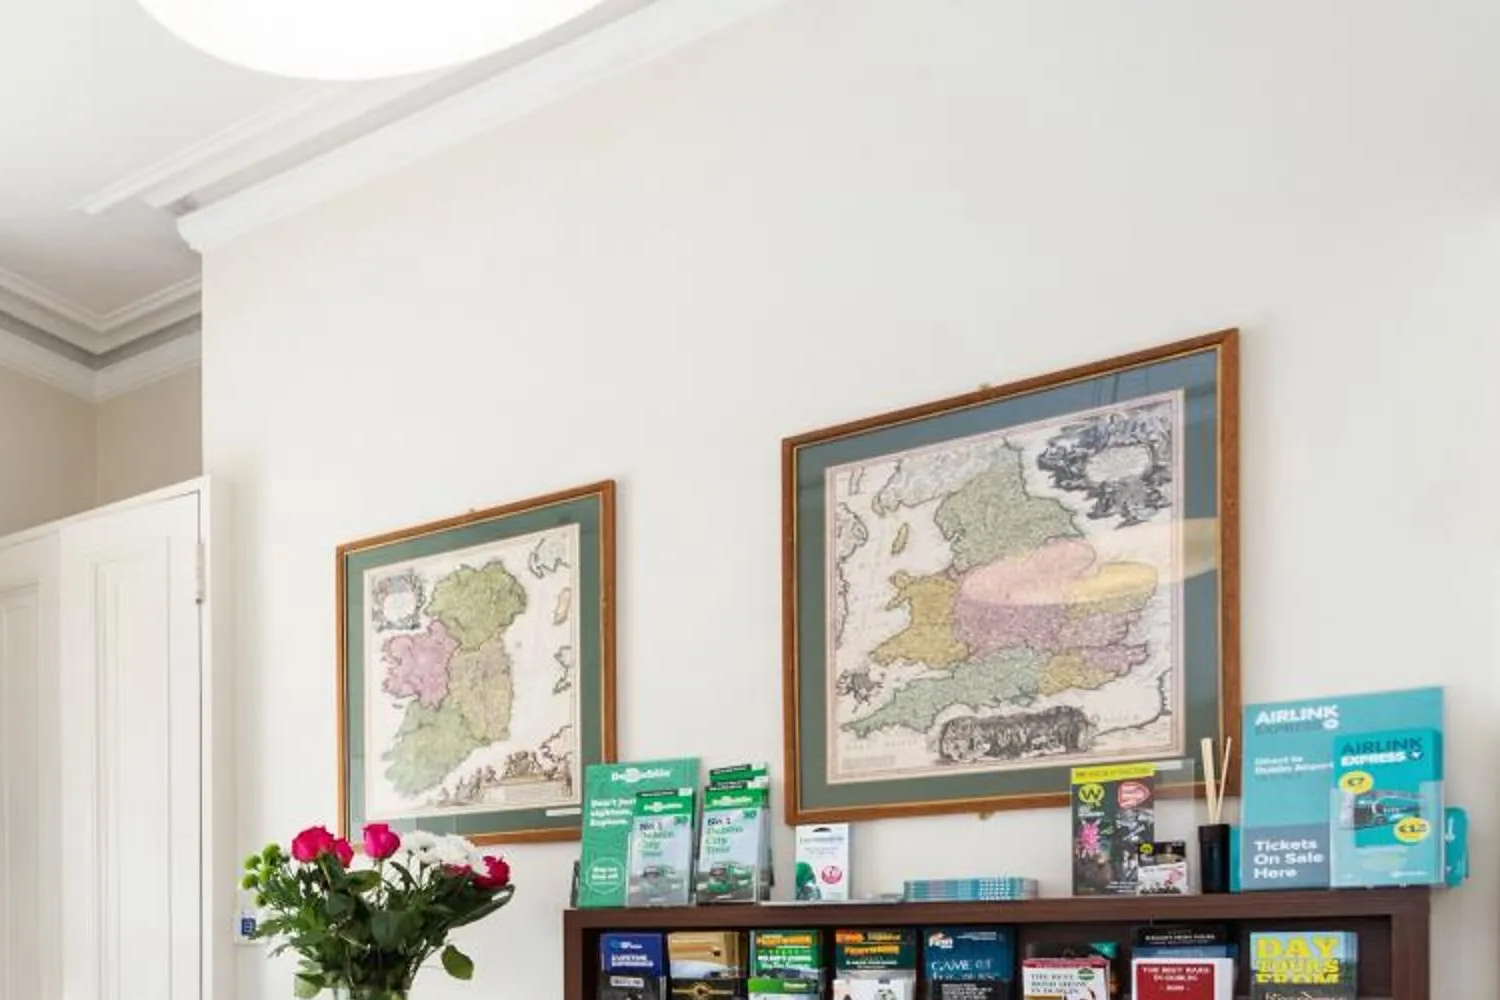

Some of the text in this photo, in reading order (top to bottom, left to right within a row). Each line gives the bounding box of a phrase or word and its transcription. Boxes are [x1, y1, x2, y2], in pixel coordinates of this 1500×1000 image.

[1255, 705, 1338, 725] AIRLINK
[1341, 737, 1424, 755] AIRLINK
[1341, 752, 1407, 767] EXPRESS
[1254, 765, 1293, 775] Dublin
[1254, 840, 1317, 852] Tickets
[1254, 853, 1324, 866] On Sale
[1254, 867, 1297, 880] Here
[1257, 937, 1339, 958] DAY
[1257, 958, 1341, 973] TOURS
